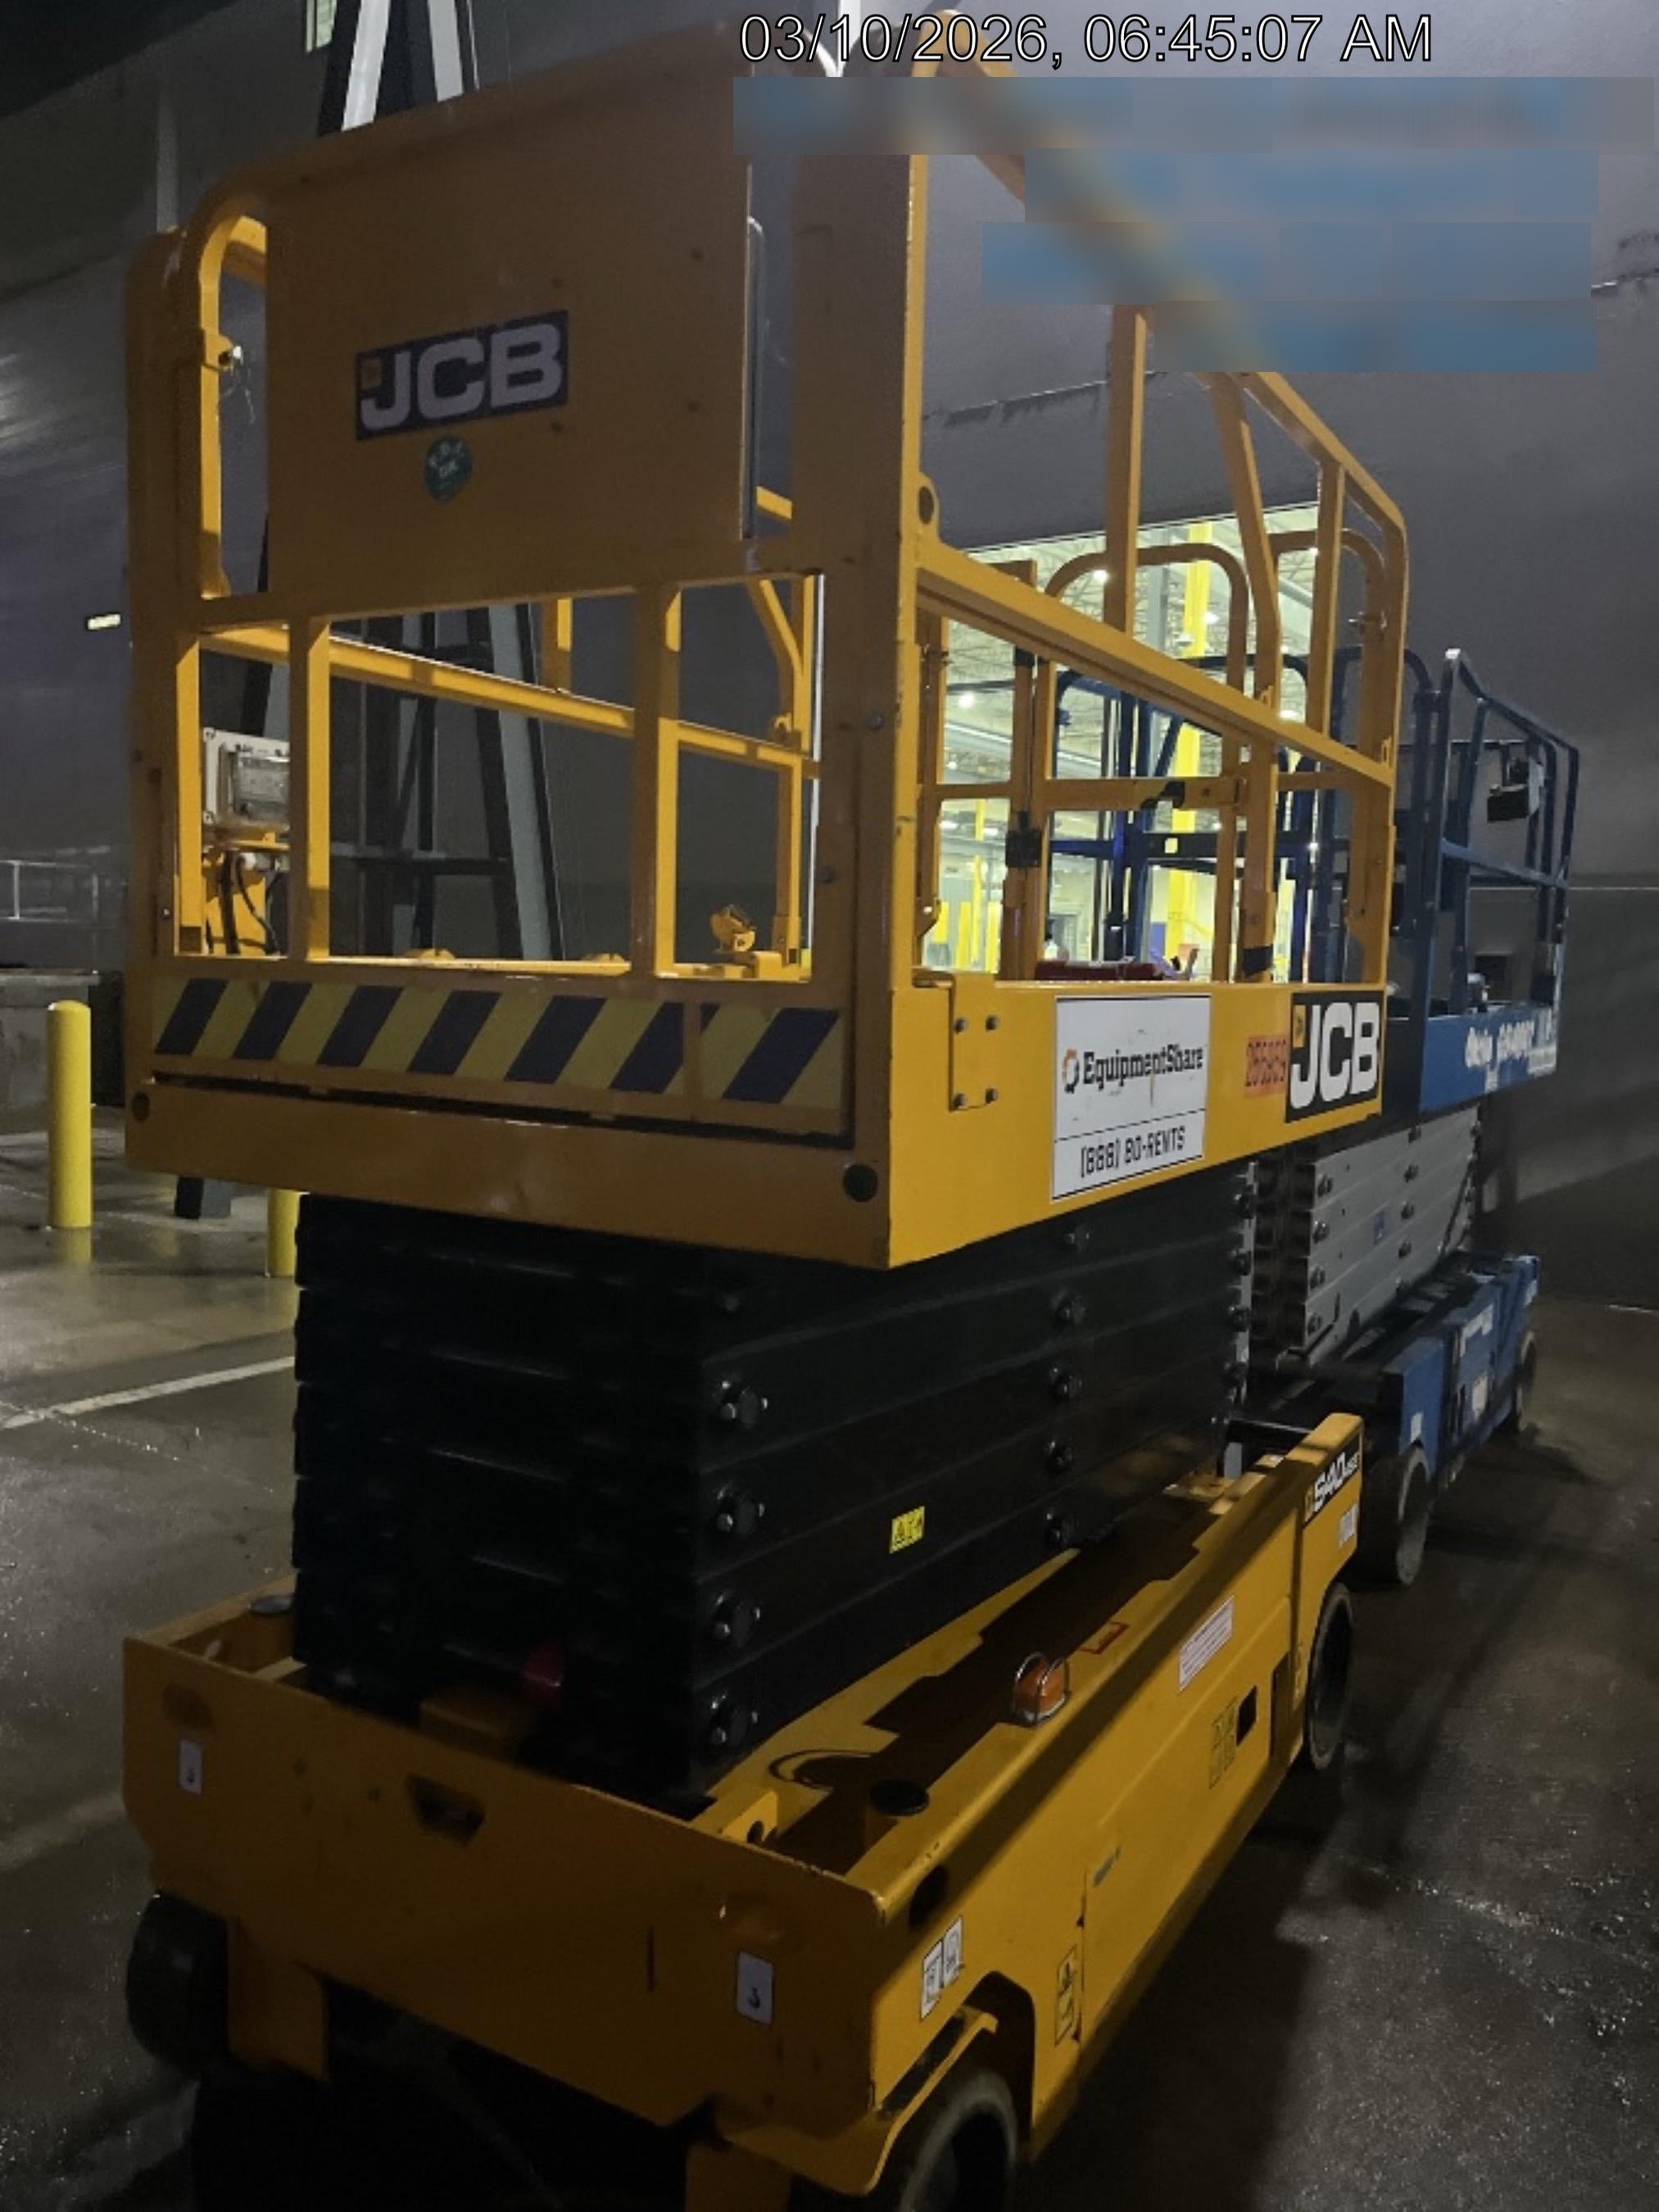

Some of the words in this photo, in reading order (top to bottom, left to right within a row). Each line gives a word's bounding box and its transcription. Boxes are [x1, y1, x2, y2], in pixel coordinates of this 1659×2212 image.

[360, 323, 563, 431] JCB
[1082, 1043, 1203, 1091] EquipmentShare
[1290, 1001, 1380, 1109] JCB
